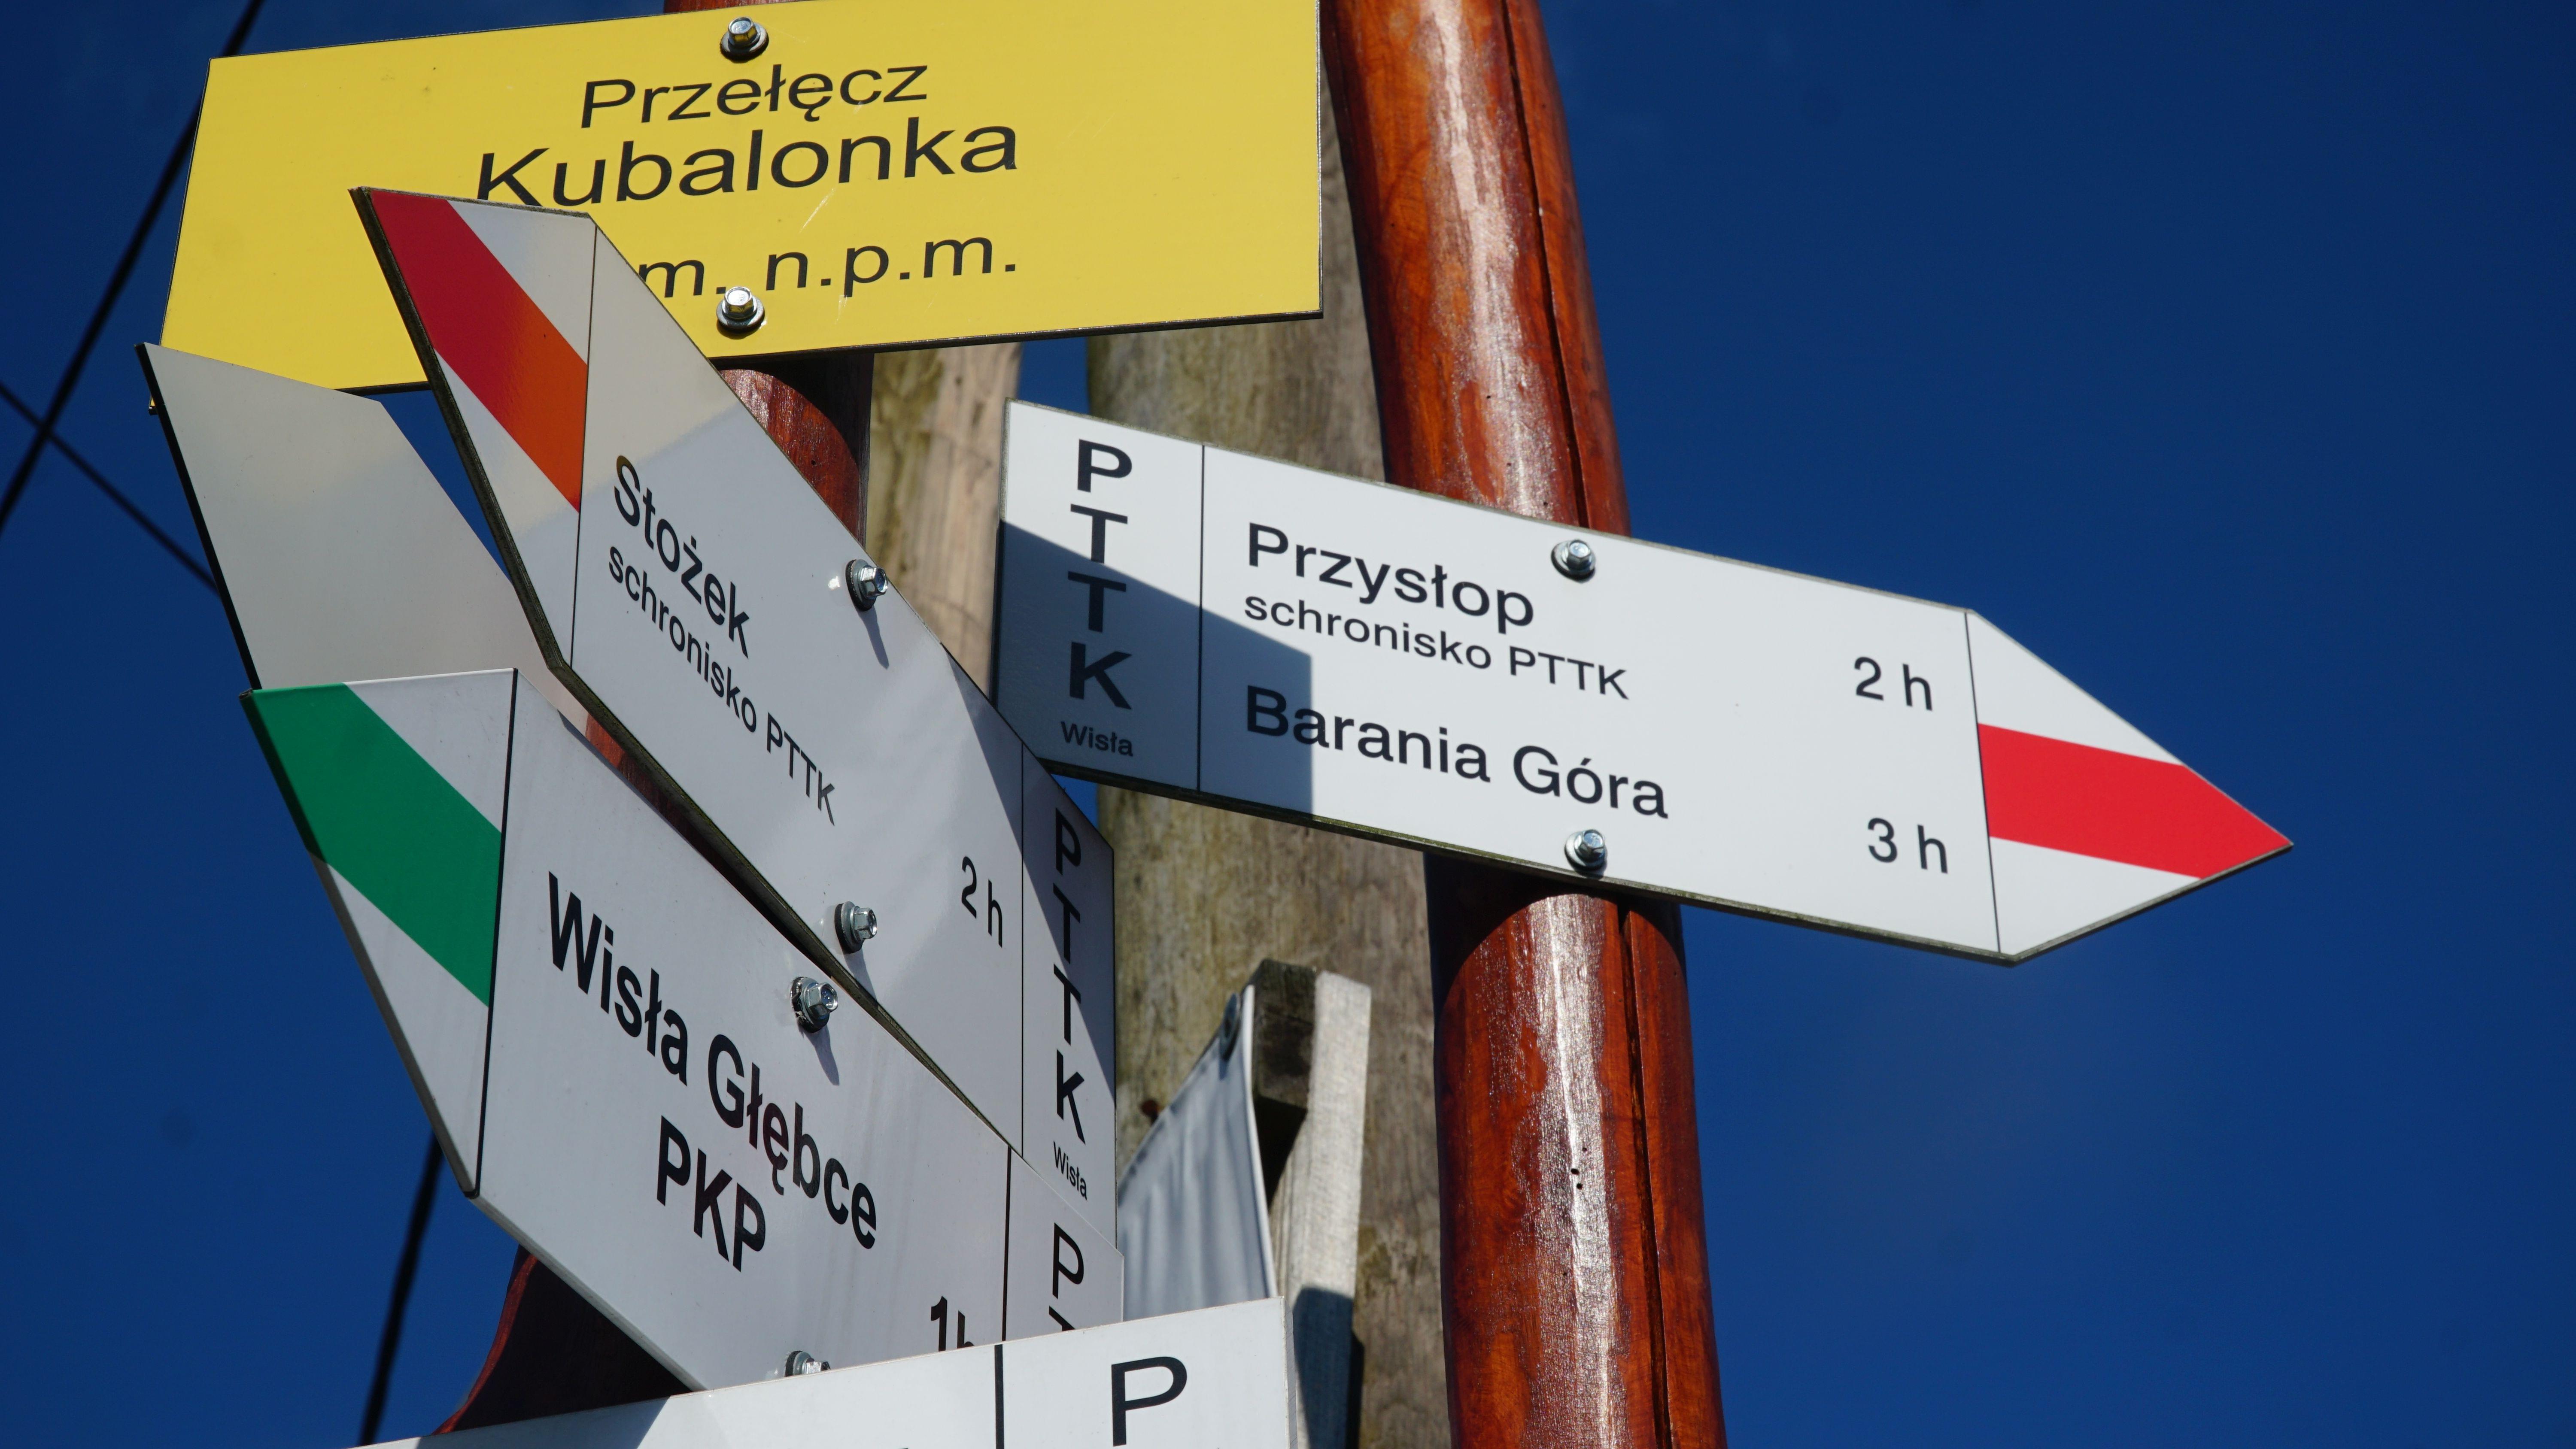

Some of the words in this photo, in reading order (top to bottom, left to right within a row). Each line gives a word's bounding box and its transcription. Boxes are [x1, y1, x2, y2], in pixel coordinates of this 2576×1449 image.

[581, 64, 928, 128] Przełęcz
[476, 116, 1017, 207] Kubalonka
[766, 236, 1016, 297] n.p.m.
[614, 455, 750, 659] Stożek
[1249, 522, 1534, 634] Przysłop
[608, 546, 757, 733] schronisko
[766, 712, 835, 826] PTTK
[1244, 595, 1492, 669] schronisko
[1509, 646, 1629, 700] PTTK
[1854, 656, 1884, 701] 2
[1902, 663, 1932, 711] h
[1061, 721, 1133, 757] Wisła
[1246, 685, 1491, 783] Barania
[1513, 745, 1668, 819] Góra
[1868, 817, 1898, 863] 3
[1917, 825, 1948, 874] h
[961, 856, 978, 919] 2
[987, 879, 1003, 948] h
[548, 870, 688, 1086] Wisła
[708, 1034, 877, 1250] Głębce
[656, 1115, 766, 1272] PKP
[1053, 1141, 1088, 1200] Wisła
